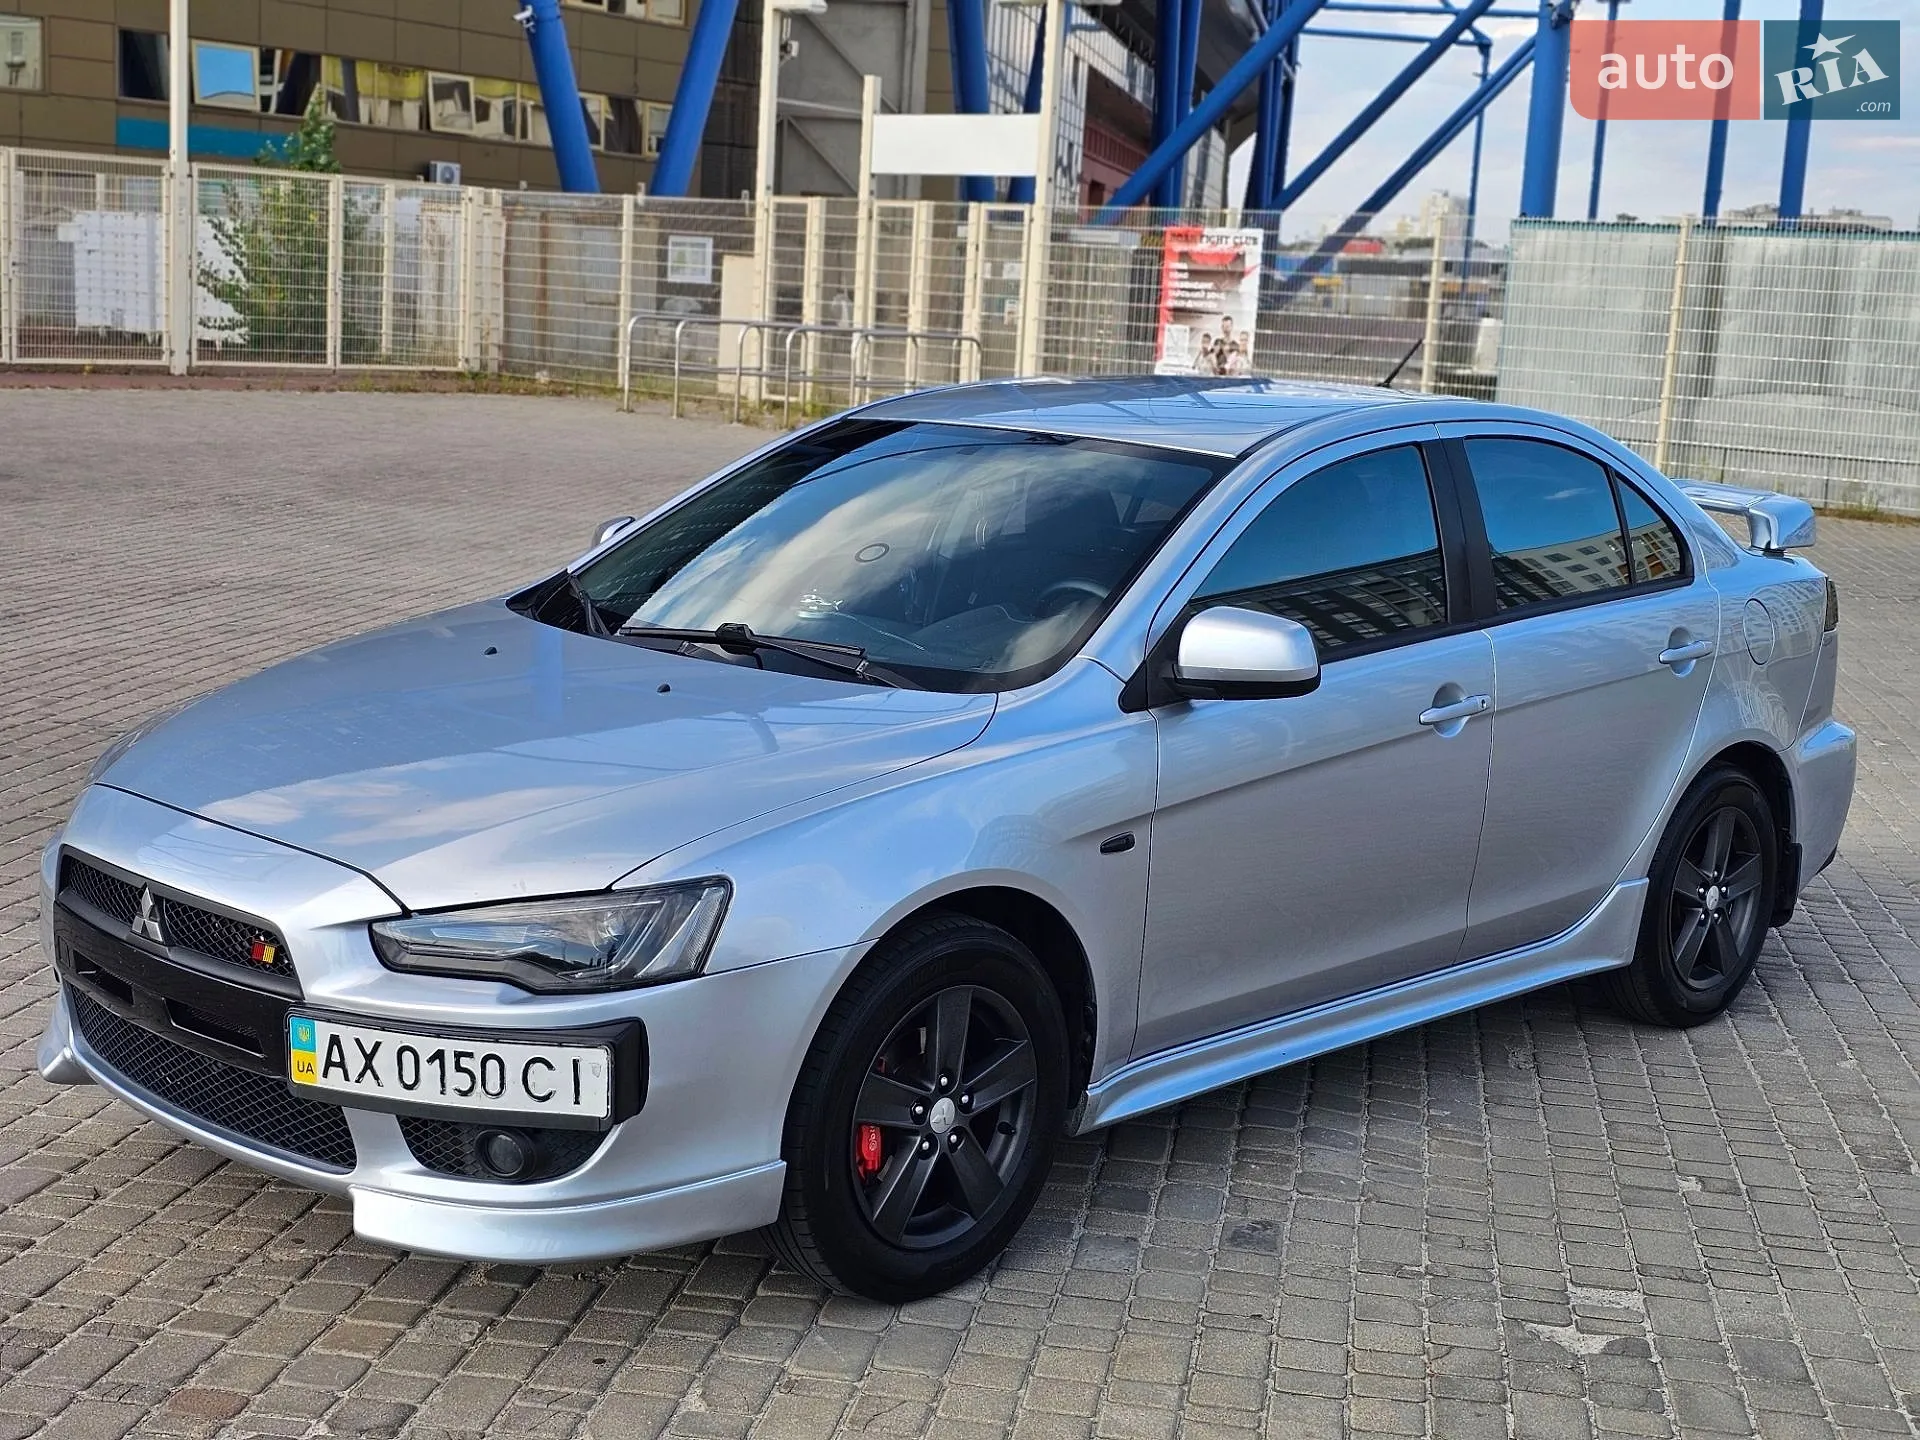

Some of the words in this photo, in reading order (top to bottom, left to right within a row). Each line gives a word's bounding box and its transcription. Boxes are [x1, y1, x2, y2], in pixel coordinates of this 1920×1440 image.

[297, 1060, 315, 1075] UA
[322, 1033, 384, 1088] AX
[396, 1045, 507, 1099] 0150
